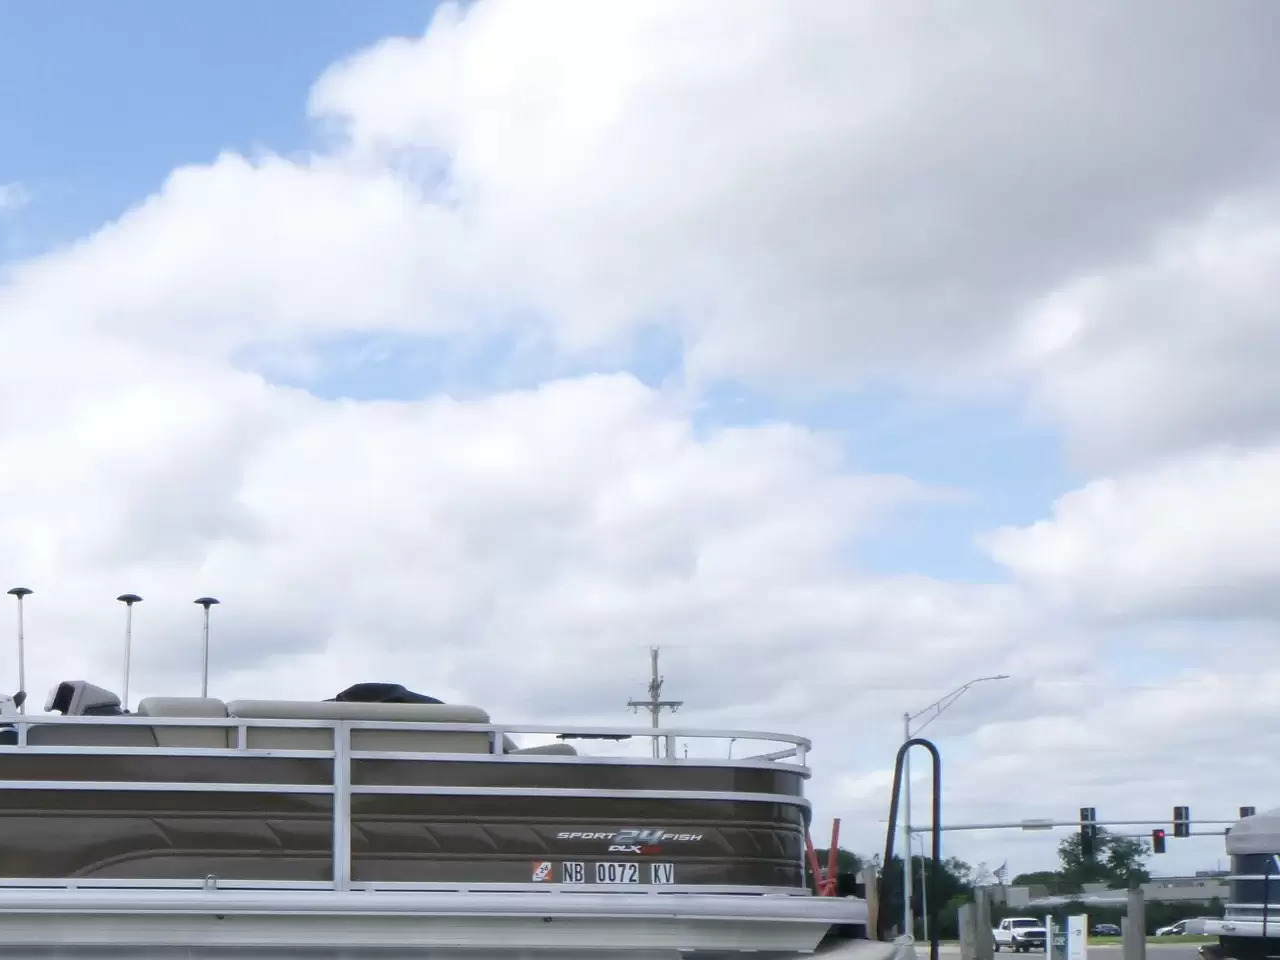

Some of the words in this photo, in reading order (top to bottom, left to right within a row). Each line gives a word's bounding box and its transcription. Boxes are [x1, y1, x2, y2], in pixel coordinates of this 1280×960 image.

[556, 831, 618, 840] SPORT
[614, 828, 664, 845] 24
[661, 833, 704, 841] FISH
[608, 844, 643, 854] DLX
[563, 863, 584, 883] NB
[597, 863, 638, 883] 0072
[652, 863, 674, 883] KV
